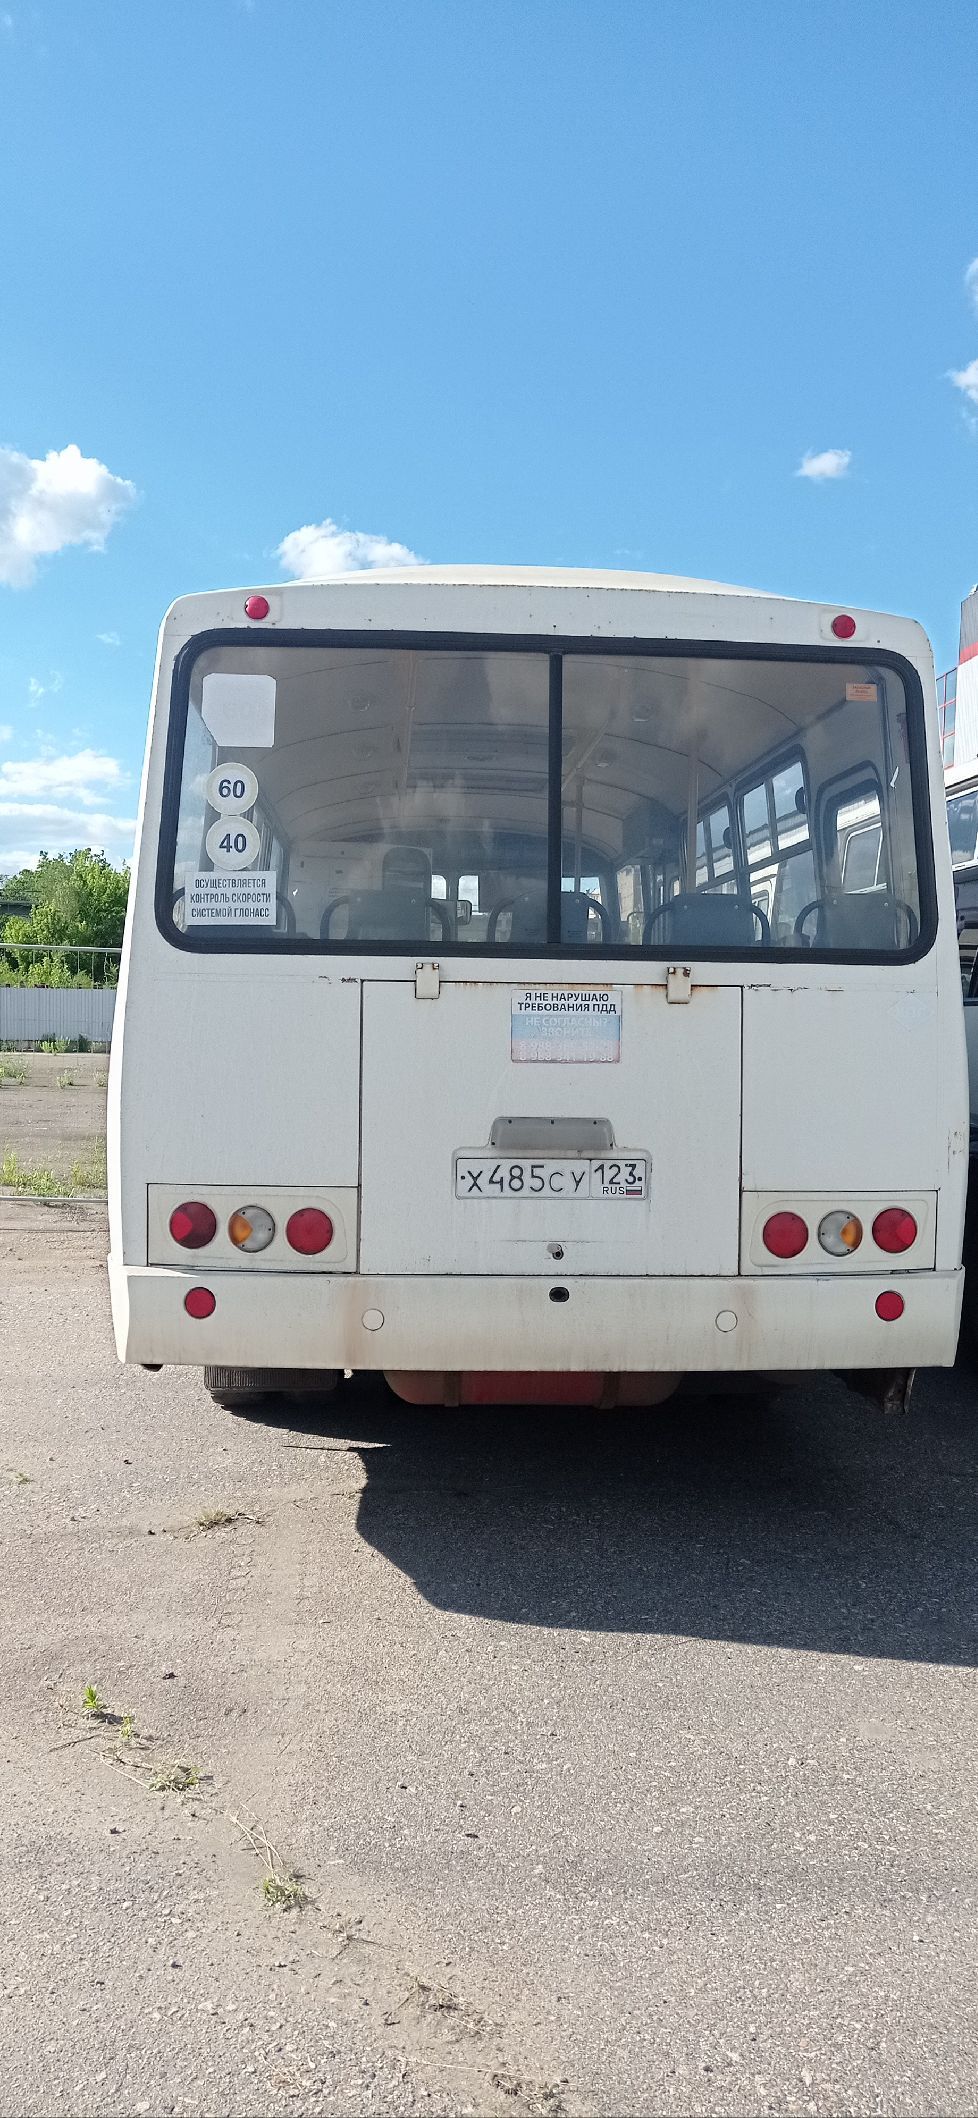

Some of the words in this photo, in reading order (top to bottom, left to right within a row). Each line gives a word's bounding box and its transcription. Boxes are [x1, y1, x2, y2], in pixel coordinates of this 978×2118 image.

[218, 779, 246, 799] 60
[219, 833, 247, 853] 40
[195, 878, 266, 890] ОСУЩЕСТВЛЯЕТСЯ
[190, 892, 230, 904] КОНТРОЛЬ
[231, 892, 271, 904] СКОРОСТИ
[191, 905, 233, 918] СИСТЕМОЙ
[233, 906, 270, 918] ГЛОНАСС
[525, 992, 532, 1002] Я
[534, 992, 549, 1002] НЕ
[551, 992, 609, 1002] НАРУШАЮ
[518, 1002, 590, 1012] ТРЕБОВАНИЯ
[592, 1003, 617, 1014] ПДД
[594, 1163, 638, 1185] 123
[602, 1186, 625, 1195] RUS
